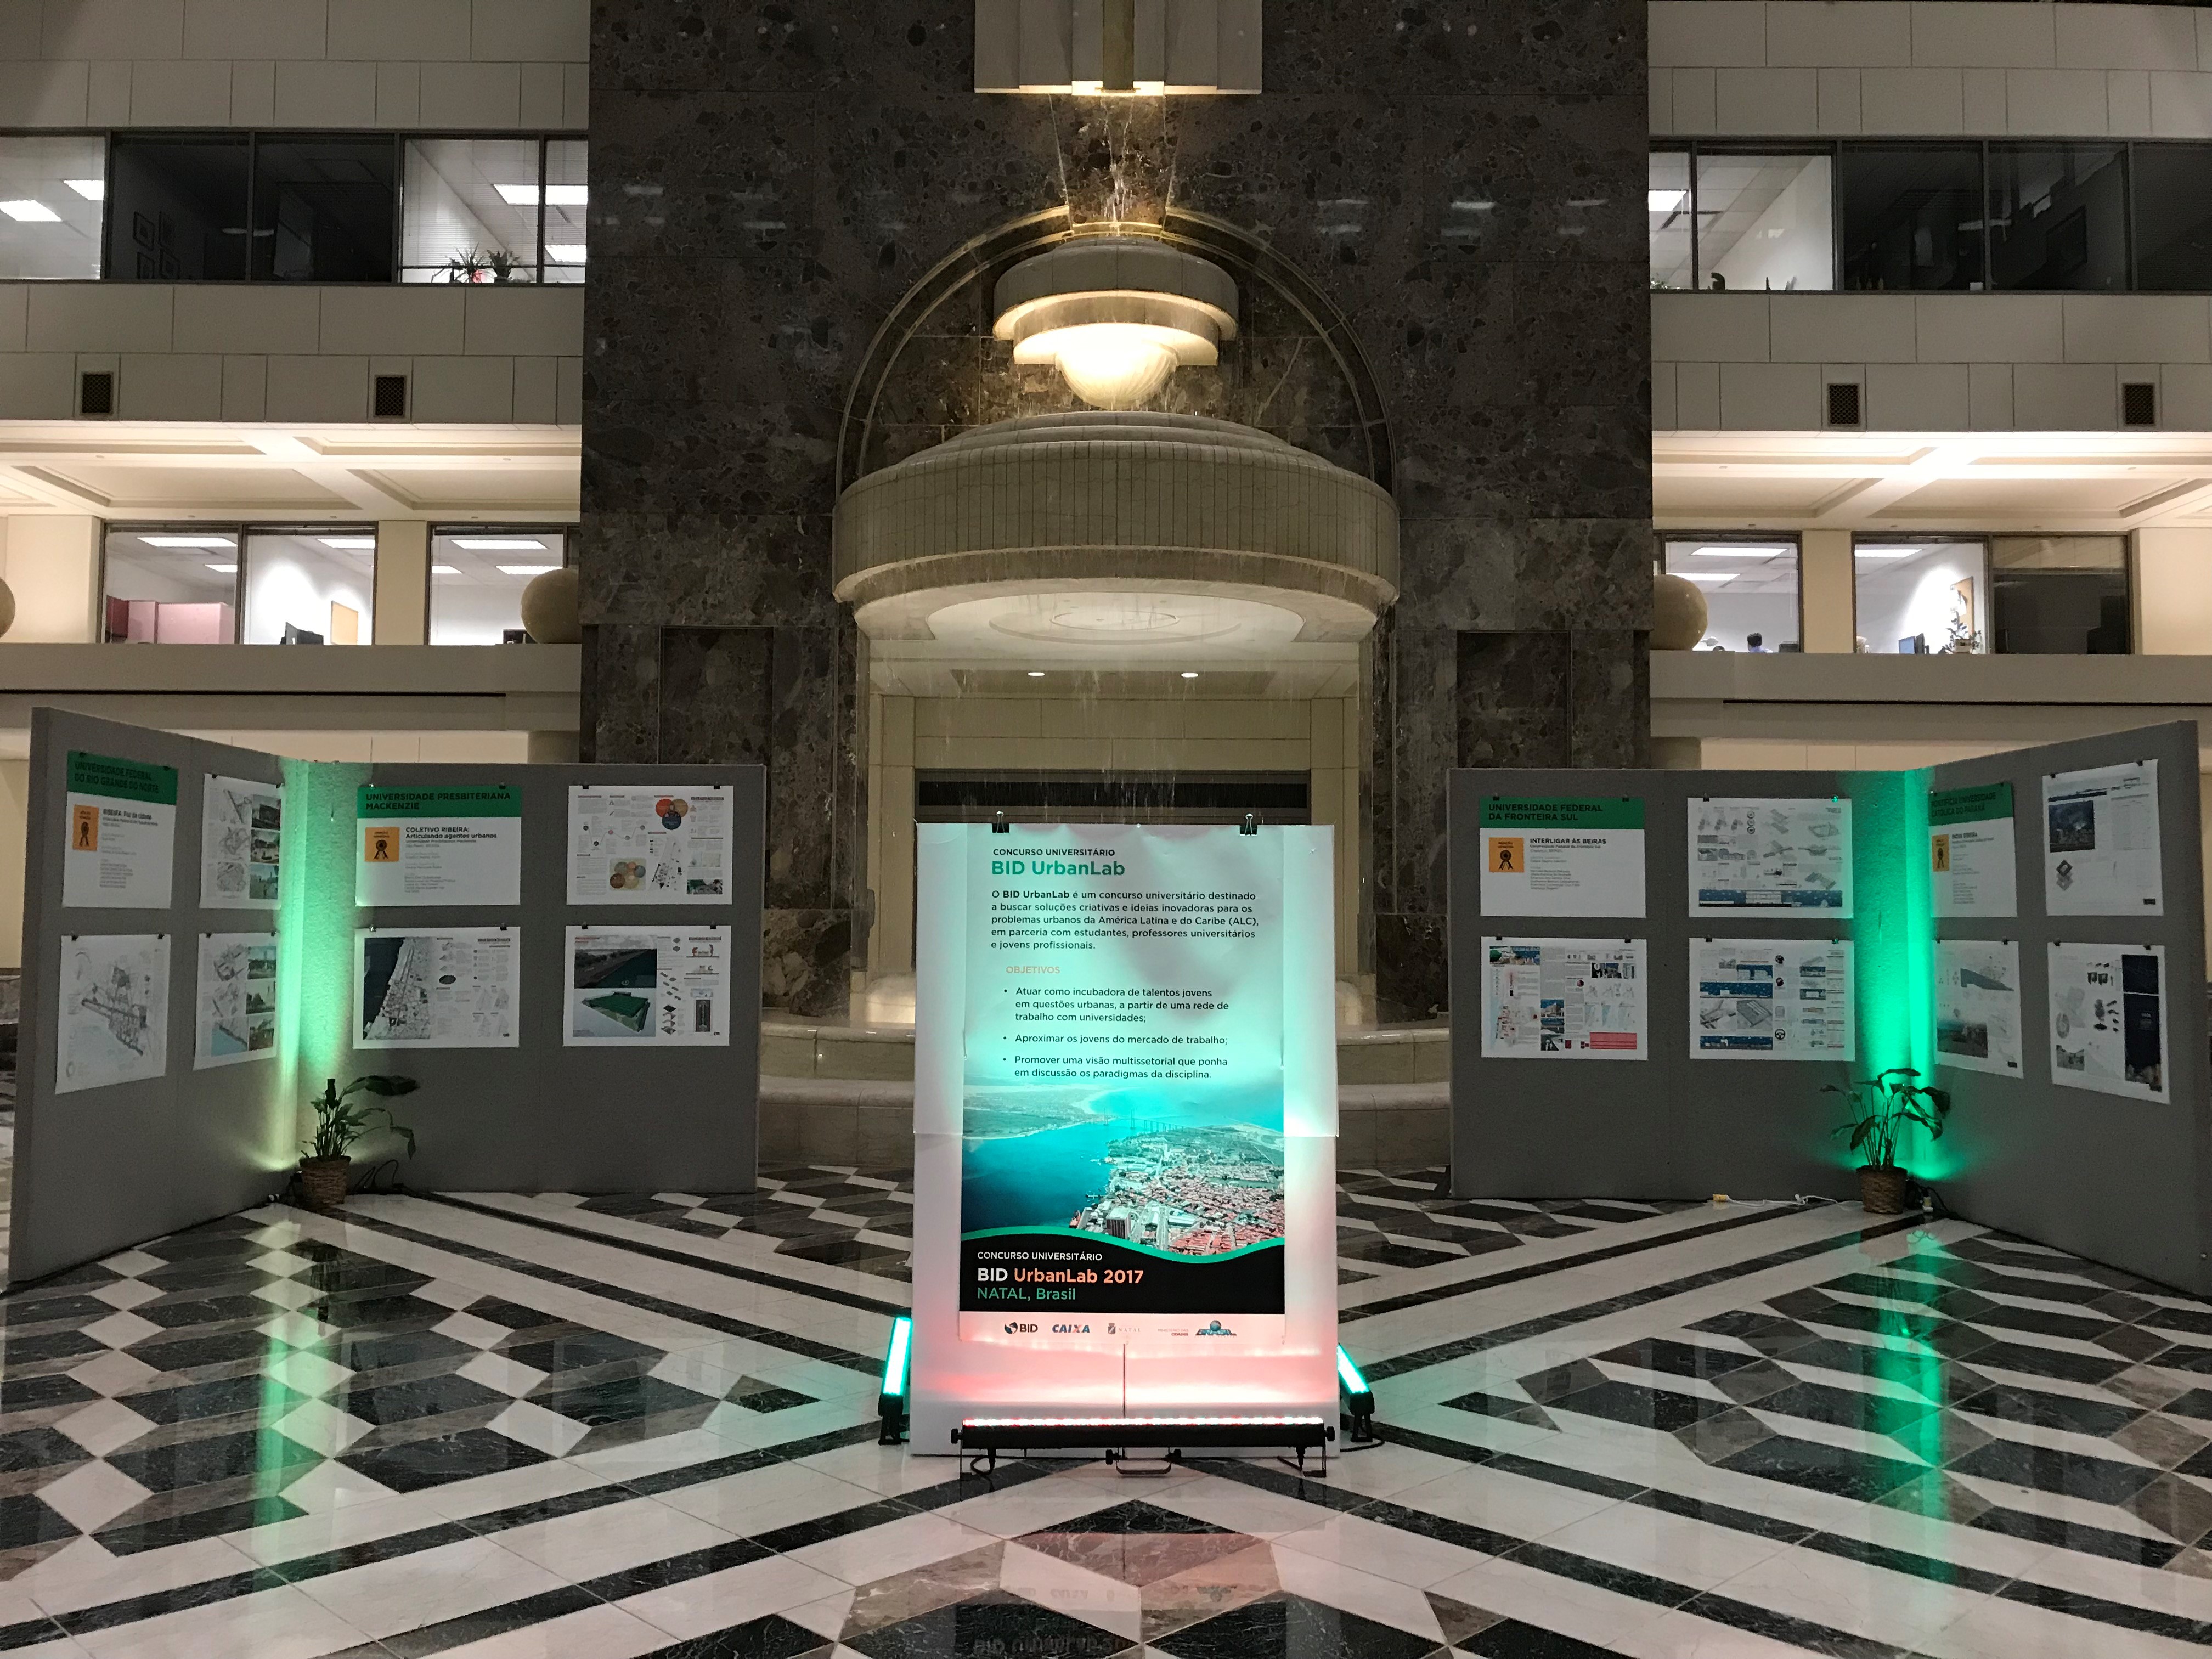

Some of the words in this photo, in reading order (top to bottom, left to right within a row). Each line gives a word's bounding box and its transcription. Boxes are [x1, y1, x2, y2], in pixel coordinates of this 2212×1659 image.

[437, 792, 510, 800] PRESBITERIANA
[365, 802, 420, 810] MACKENZIE
[1046, 847, 1115, 856] UNIVERSITÁRIO
[992, 860, 1025, 875] BID
[1032, 860, 1125, 876] UrbanLab
[991, 890, 1000, 898] O
[1023, 890, 1070, 899] UrbanLab
[1073, 890, 1079, 899] é
[1146, 891, 1205, 900] universitário
[1208, 891, 1256, 900] destinado
[1000, 902, 1032, 911] buscar
[1035, 903, 1076, 912] soluções
[1079, 903, 1119, 912] criativas
[1131, 903, 1159, 912] ideias
[1161, 904, 1214, 912] inovadoras
[991, 915, 1041, 924] problemas
[1043, 916, 1081, 924] urbanos
[1084, 916, 1096, 924] da
[1098, 916, 1137, 924] América
[1140, 916, 1169, 924] Latina
[1180, 916, 1192, 925] do
[1195, 917, 1226, 925] Caribe
[1228, 917, 1259, 927] (ALC),
[1009, 928, 1048, 937] parceria
[1074, 928, 1129, 938] estudantes,
[1132, 928, 1188, 938] professores
[1190, 929, 1255, 938] universitários
[999, 940, 1030, 950] jovens
[1033, 940, 1096, 950] profissionais.
[1005, 966, 1060, 975] OBJETIVOS
[1015, 987, 1042, 995] Atuar
[1073, 988, 1125, 996] incubadora
[1127, 988, 1140, 996] de
[1142, 988, 1180, 997] talentos
[1182, 989, 1212, 998] jovens
[1032, 1000, 1075, 1009] questões
[1077, 1000, 1116, 1010] urbanas,
[1127, 1001, 1154, 1011] partir
[1155, 1001, 1168, 1009] de
[1193, 1001, 1215, 1010] rede
[1217, 1001, 1229, 1010] de
[1080, 1013, 1146, 1023] universidades;
[1015, 1034, 1064, 1043] Aproximar
[1079, 1035, 1110, 1044] jovens
[1112, 1035, 1125, 1043] do
[1127, 1035, 1169, 1043] mercado
[1171, 1035, 1184, 1044] de
[1186, 1036, 1227, 1045] trabalho;
[1015, 1056, 1060, 1064] Promover
[1086, 1056, 1110, 1064] visão
[1113, 1057, 1175, 1065] multissetorial
[1178, 1059, 1195, 1067] que
[1198, 1058, 1227, 1067] ponha
[1031, 1068, 1077, 1077] discussão
[1093, 1069, 1148, 1079] paradigmas
[1150, 1070, 1163, 1078] da
[1165, 1070, 1211, 1080] disciplina.
[977, 1251, 1029, 1260] CONCURSO
[1031, 1251, 1102, 1261] UNIVERSITÁRIO
[978, 1268, 1008, 1282] BID
[1014, 1268, 1098, 1283] UrbanLab
[1103, 1269, 1144, 1284] 2017
[977, 1287, 1031, 1301] NATAL,
[1036, 1288, 1076, 1300] Brasil
[1019, 1323, 1039, 1333] BID
[1052, 1324, 1090, 1333] CAIXA
